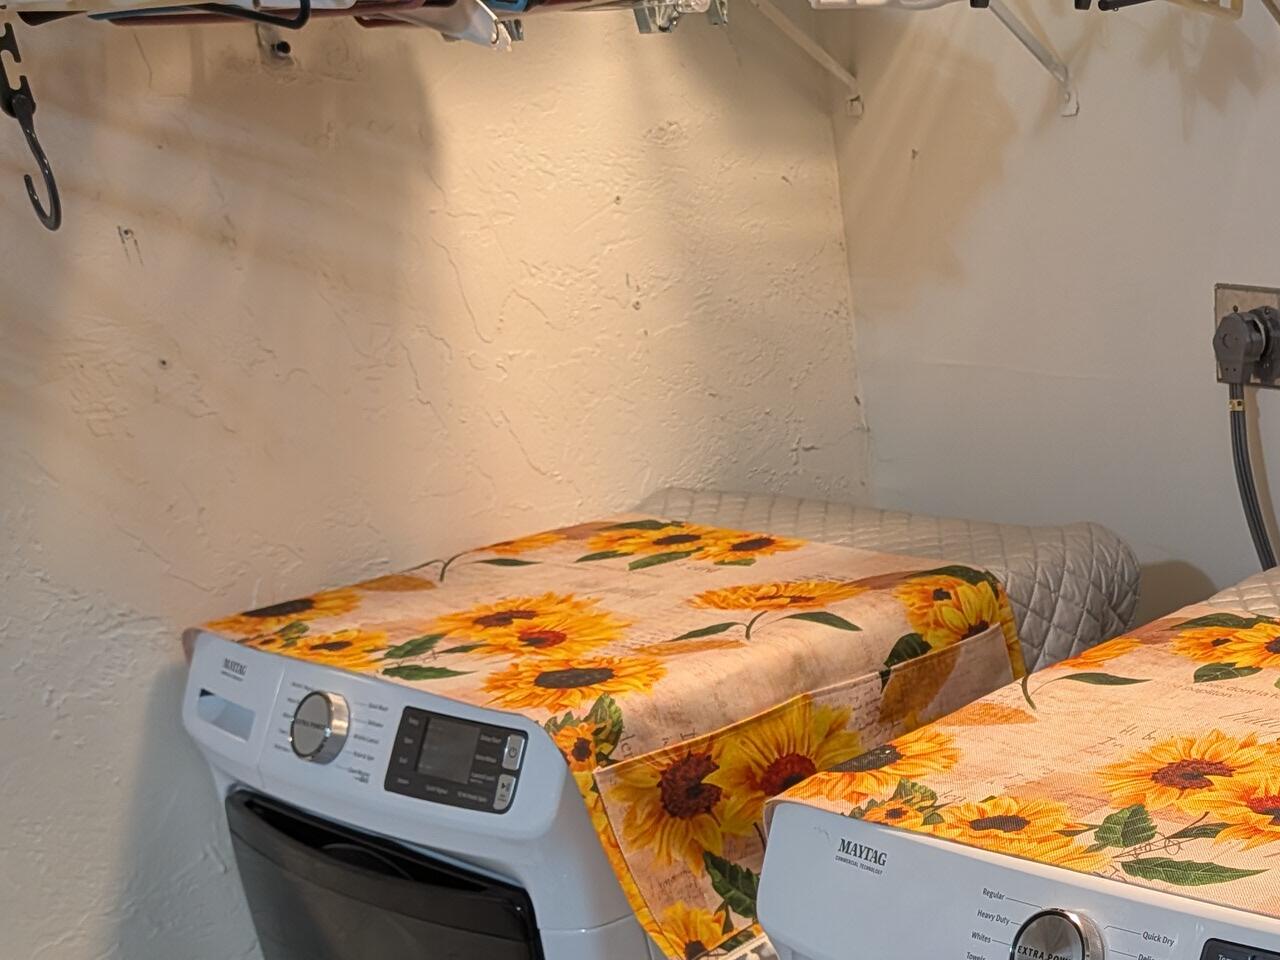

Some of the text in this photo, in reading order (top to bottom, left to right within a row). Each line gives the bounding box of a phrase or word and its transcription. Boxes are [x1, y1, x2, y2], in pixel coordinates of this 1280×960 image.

[838, 838, 888, 867] MAYTAG
[982, 886, 1005, 900] Regular
[977, 909, 1010, 926] Heavy Duty
[971, 931, 991, 943] Whites
[1142, 931, 1175, 947] Quick Dry
[1017, 945, 1045, 960] EXTRA
